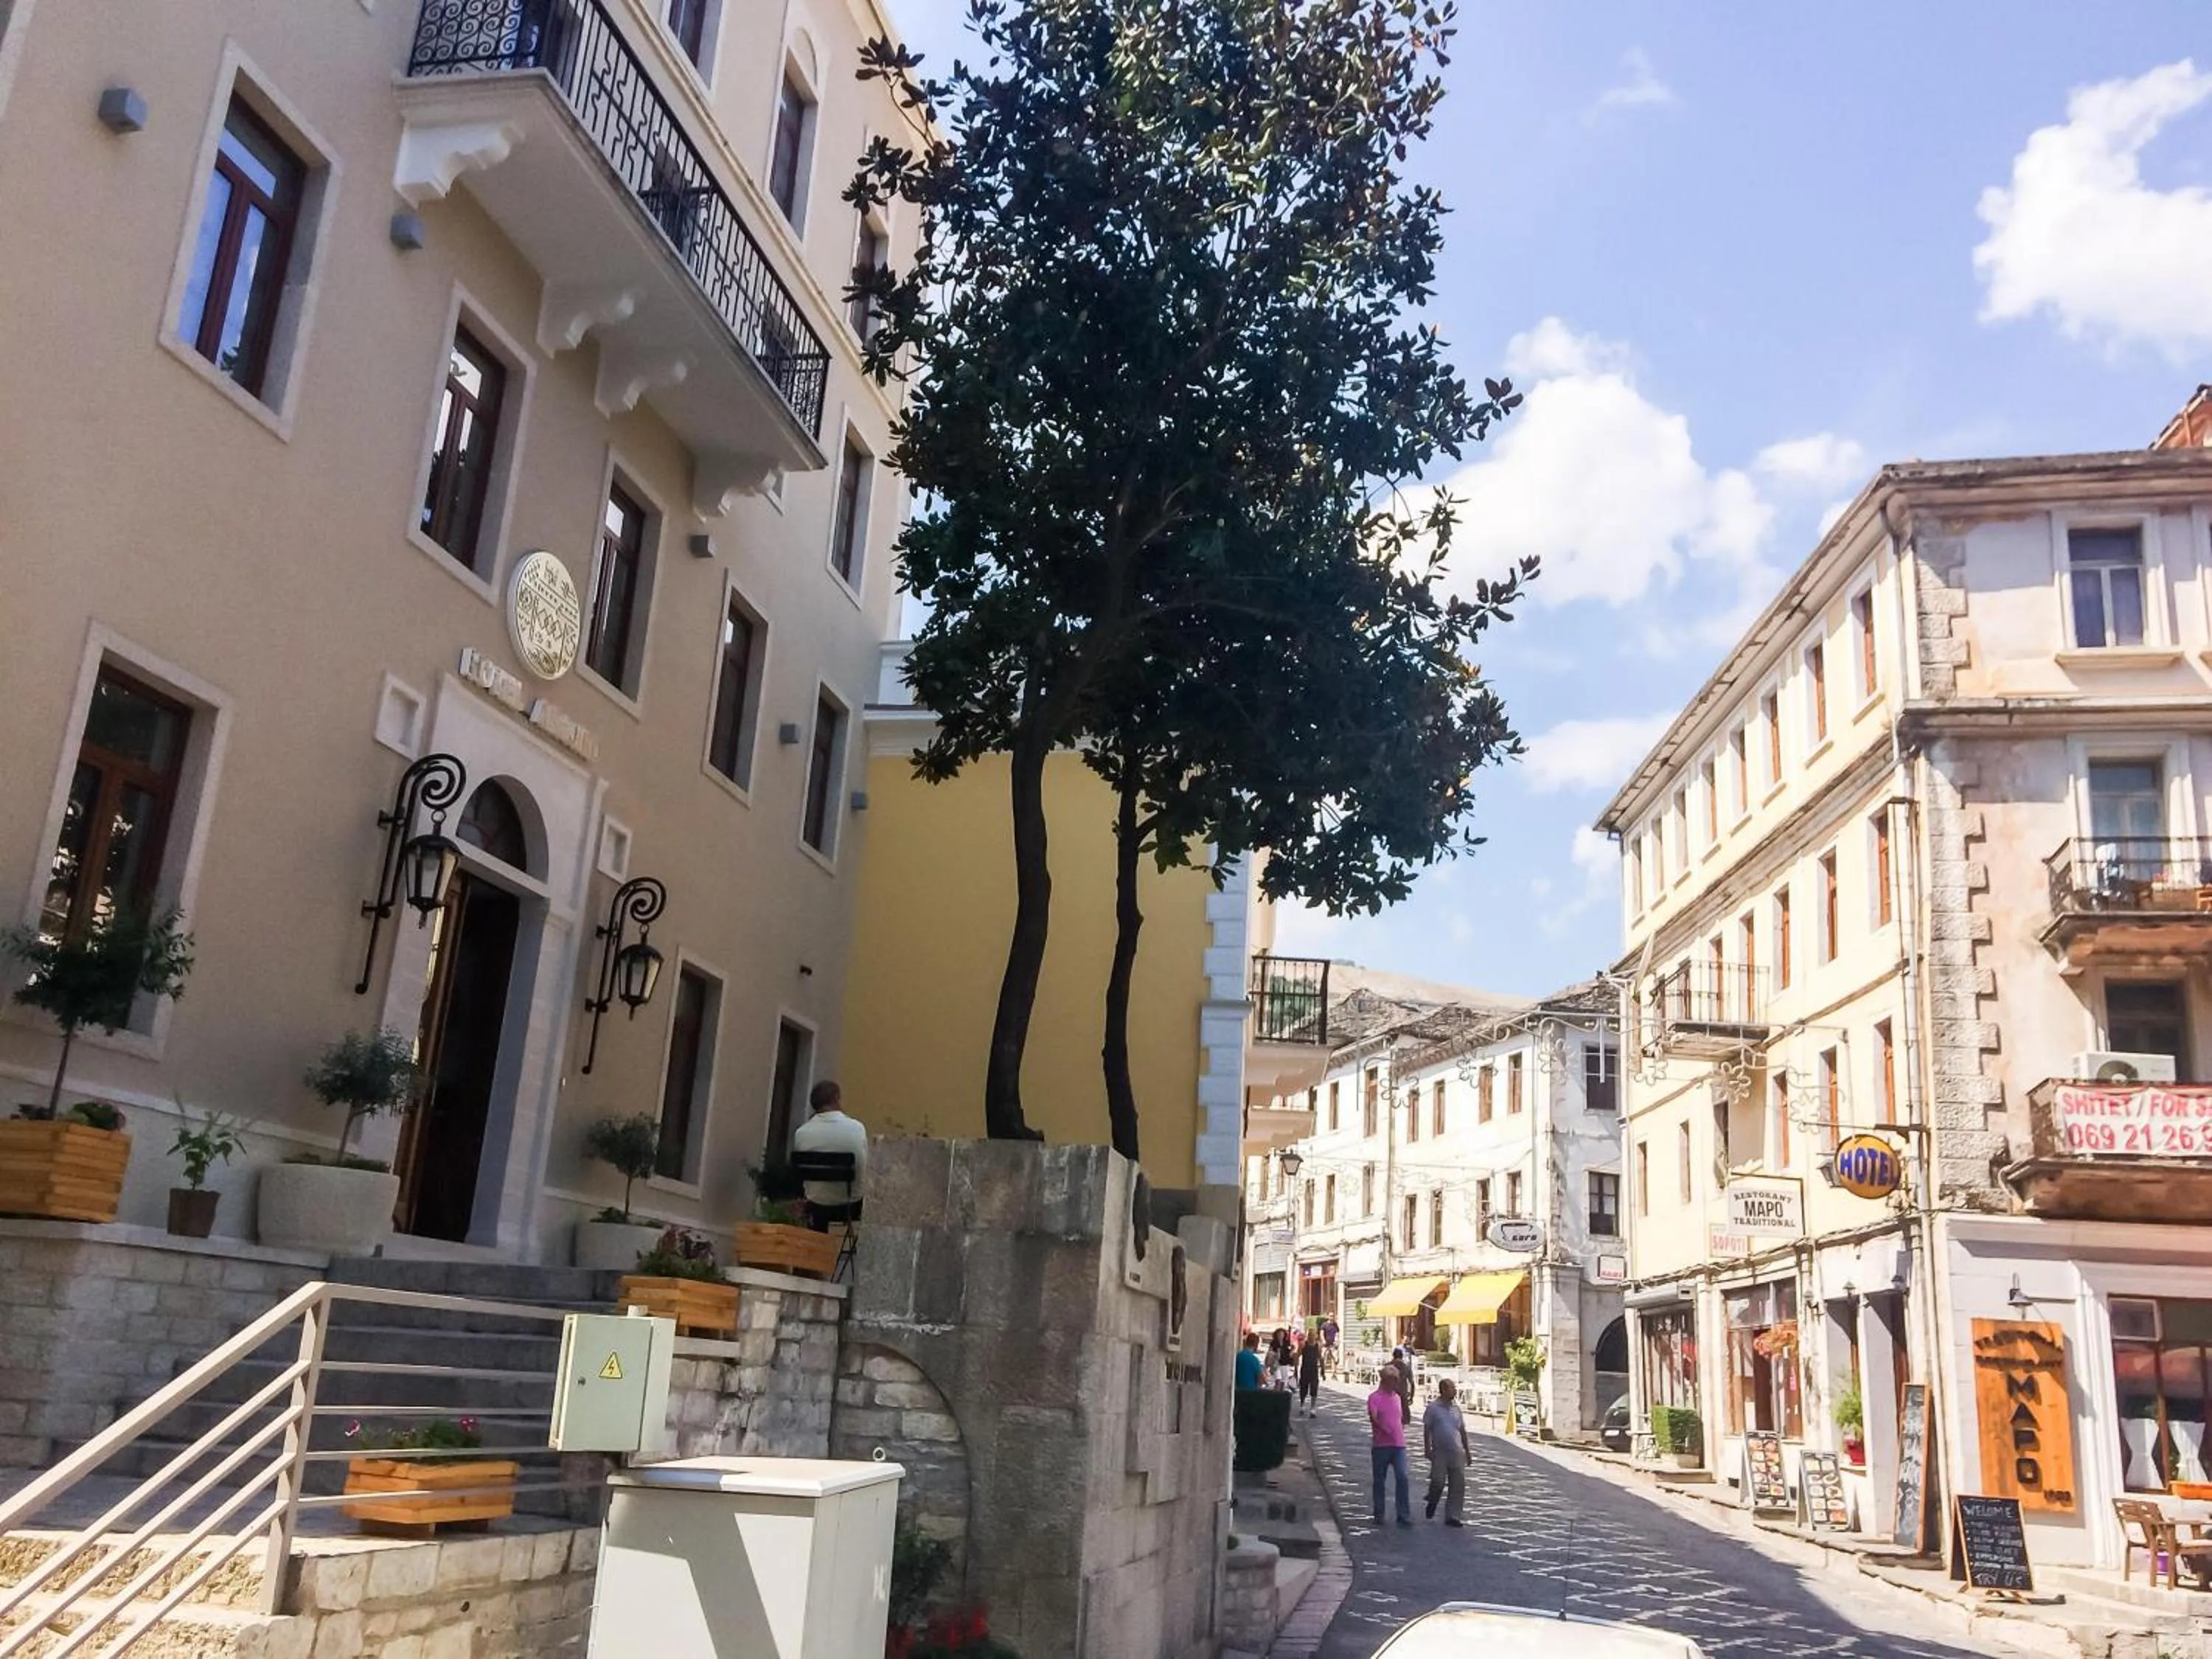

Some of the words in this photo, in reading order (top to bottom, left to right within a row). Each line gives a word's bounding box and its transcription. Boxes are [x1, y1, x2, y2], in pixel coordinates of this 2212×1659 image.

[2062, 1093, 2132, 1116] SHITET
[2150, 1094, 2188, 1117] FOR
[2068, 1123, 2115, 1150] 069
[2123, 1124, 2152, 1150] 21
[2162, 1124, 2194, 1150] 26
[1840, 1147, 1896, 1186] HOTEL
[1734, 1192, 1792, 1203] RESTORANT
[1745, 1200, 1783, 1217] MAPO
[1734, 1217, 1796, 1227] TRADITIONAL
